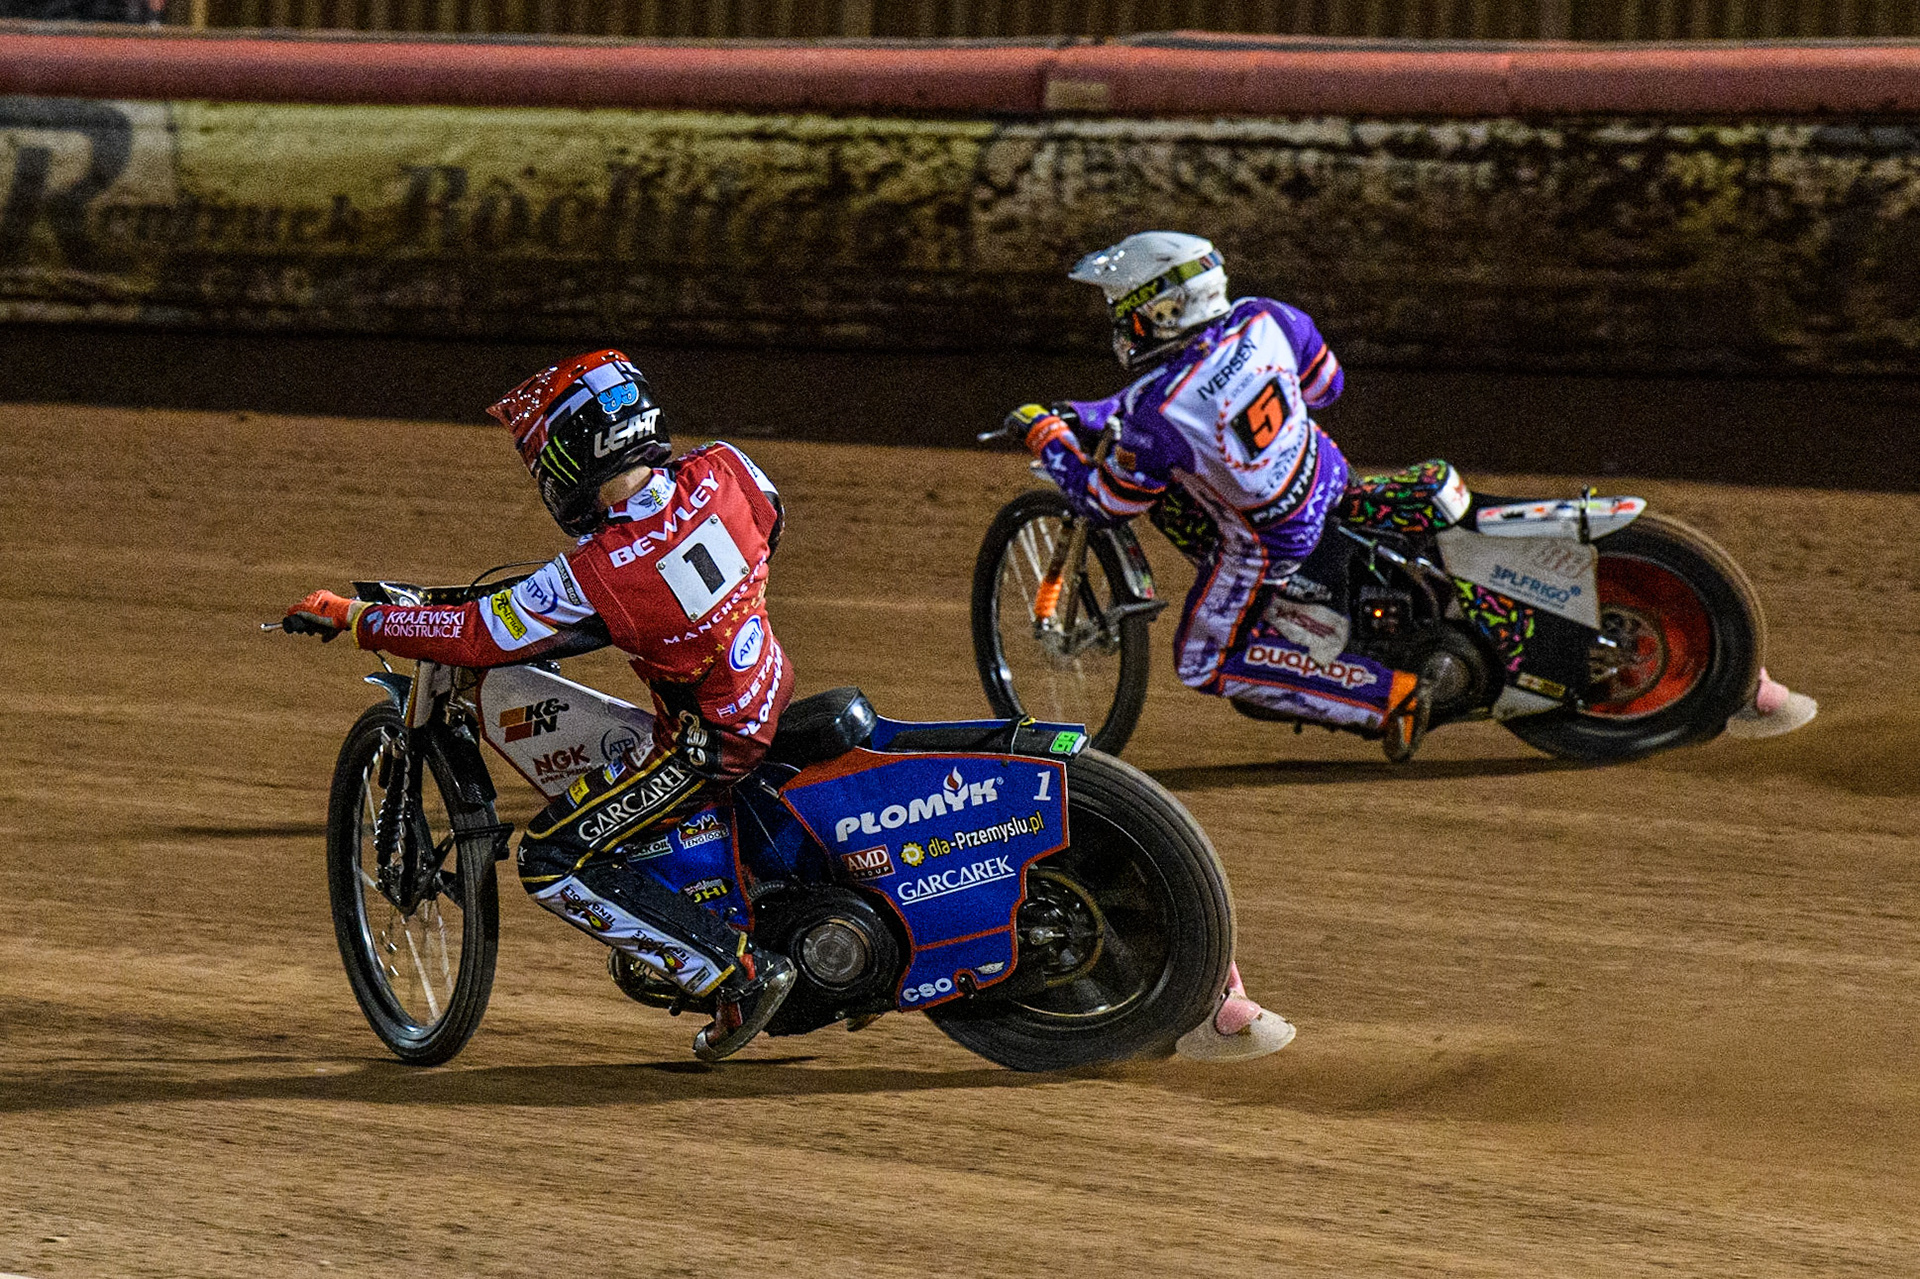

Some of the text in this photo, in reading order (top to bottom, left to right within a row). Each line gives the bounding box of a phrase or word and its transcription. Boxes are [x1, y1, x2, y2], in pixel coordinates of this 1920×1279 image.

[1197, 336, 1258, 400] IVERSEN
[594, 407, 661, 458] LEATT
[1246, 382, 1284, 449] 5
[609, 470, 719, 568] BEWLEY
[682, 543, 726, 594] 1
[525, 576, 548, 605] ATPI
[384, 624, 463, 638] KONSTRUKCJE
[386, 610, 465, 625] KRAJEWSKI
[739, 627, 760, 661] ATPI
[737, 636, 775, 709] BETA
[533, 744, 590, 776] NGK
[608, 737, 636, 756] ATPI
[1033, 770, 1051, 801] 1
[835, 777, 997, 842] PŁOMYK
[929, 812, 1044, 858] dla-Przemyslu.pl
[848, 849, 888, 871] AMD
[897, 855, 1015, 900] GARCAREK
[903, 977, 952, 1002] CSO
